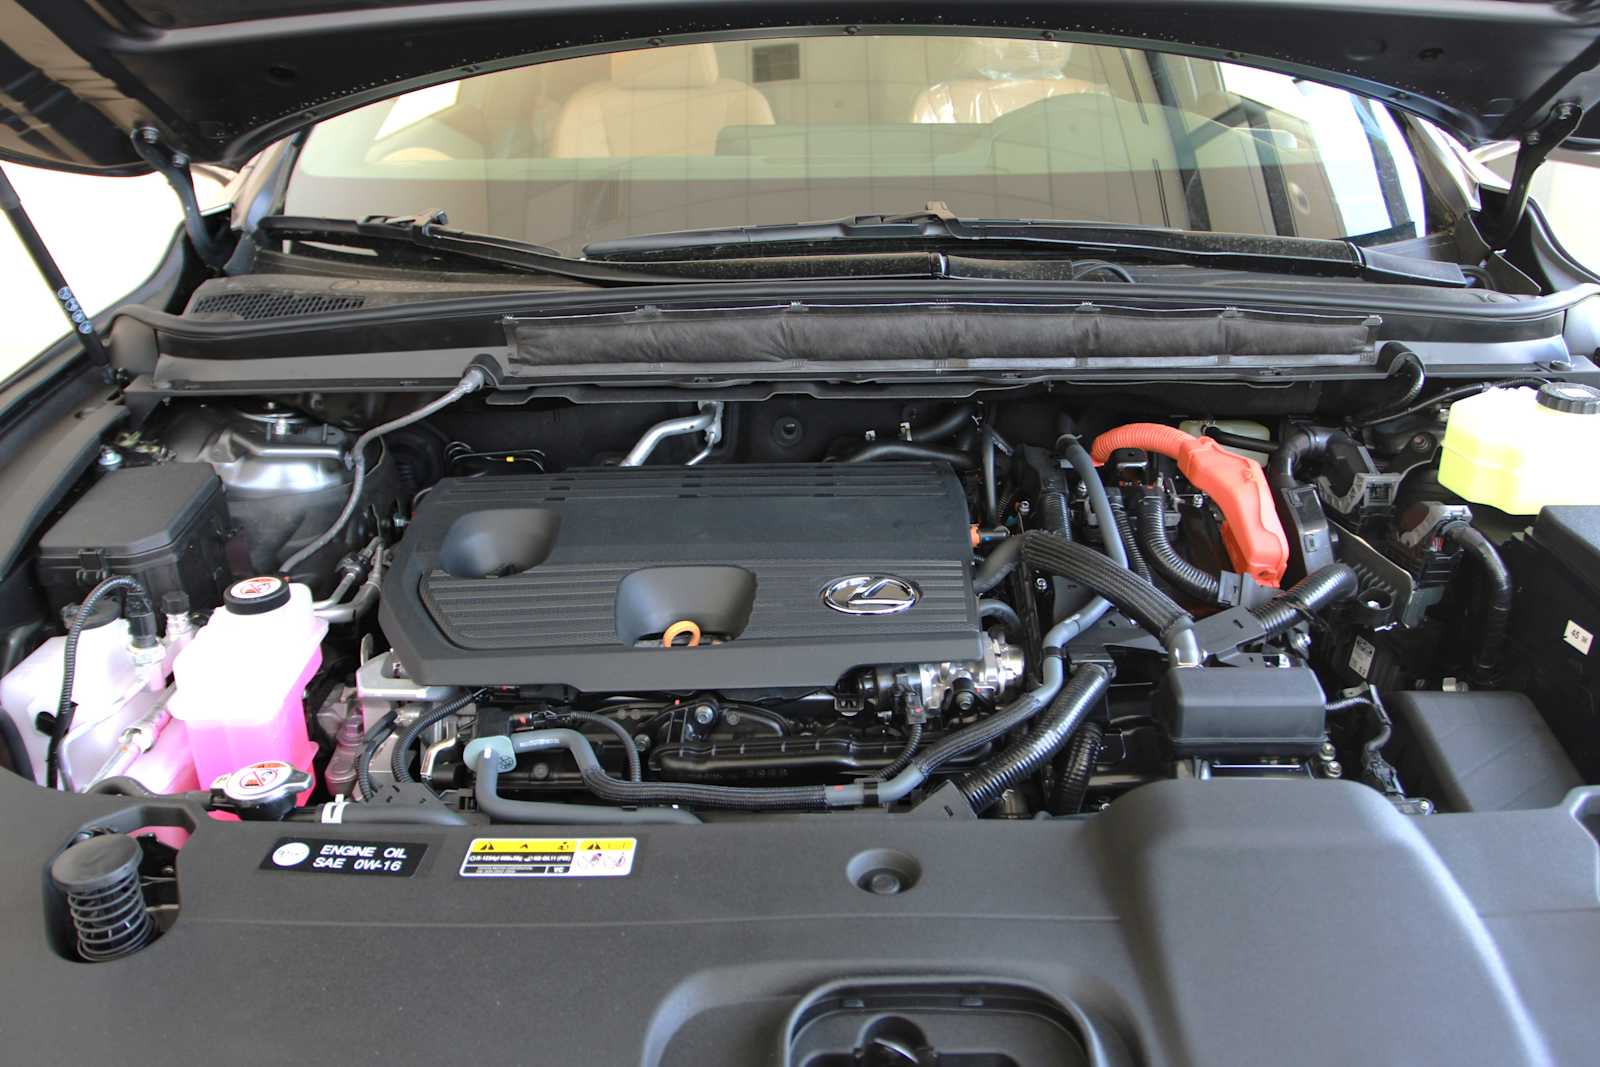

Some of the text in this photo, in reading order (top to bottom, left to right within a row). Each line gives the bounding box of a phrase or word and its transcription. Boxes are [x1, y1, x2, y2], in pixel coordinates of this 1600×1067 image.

[319, 844, 376, 857] ENGINE
[383, 847, 407, 859] OIL
[312, 858, 402, 872] SAE 0W-16
